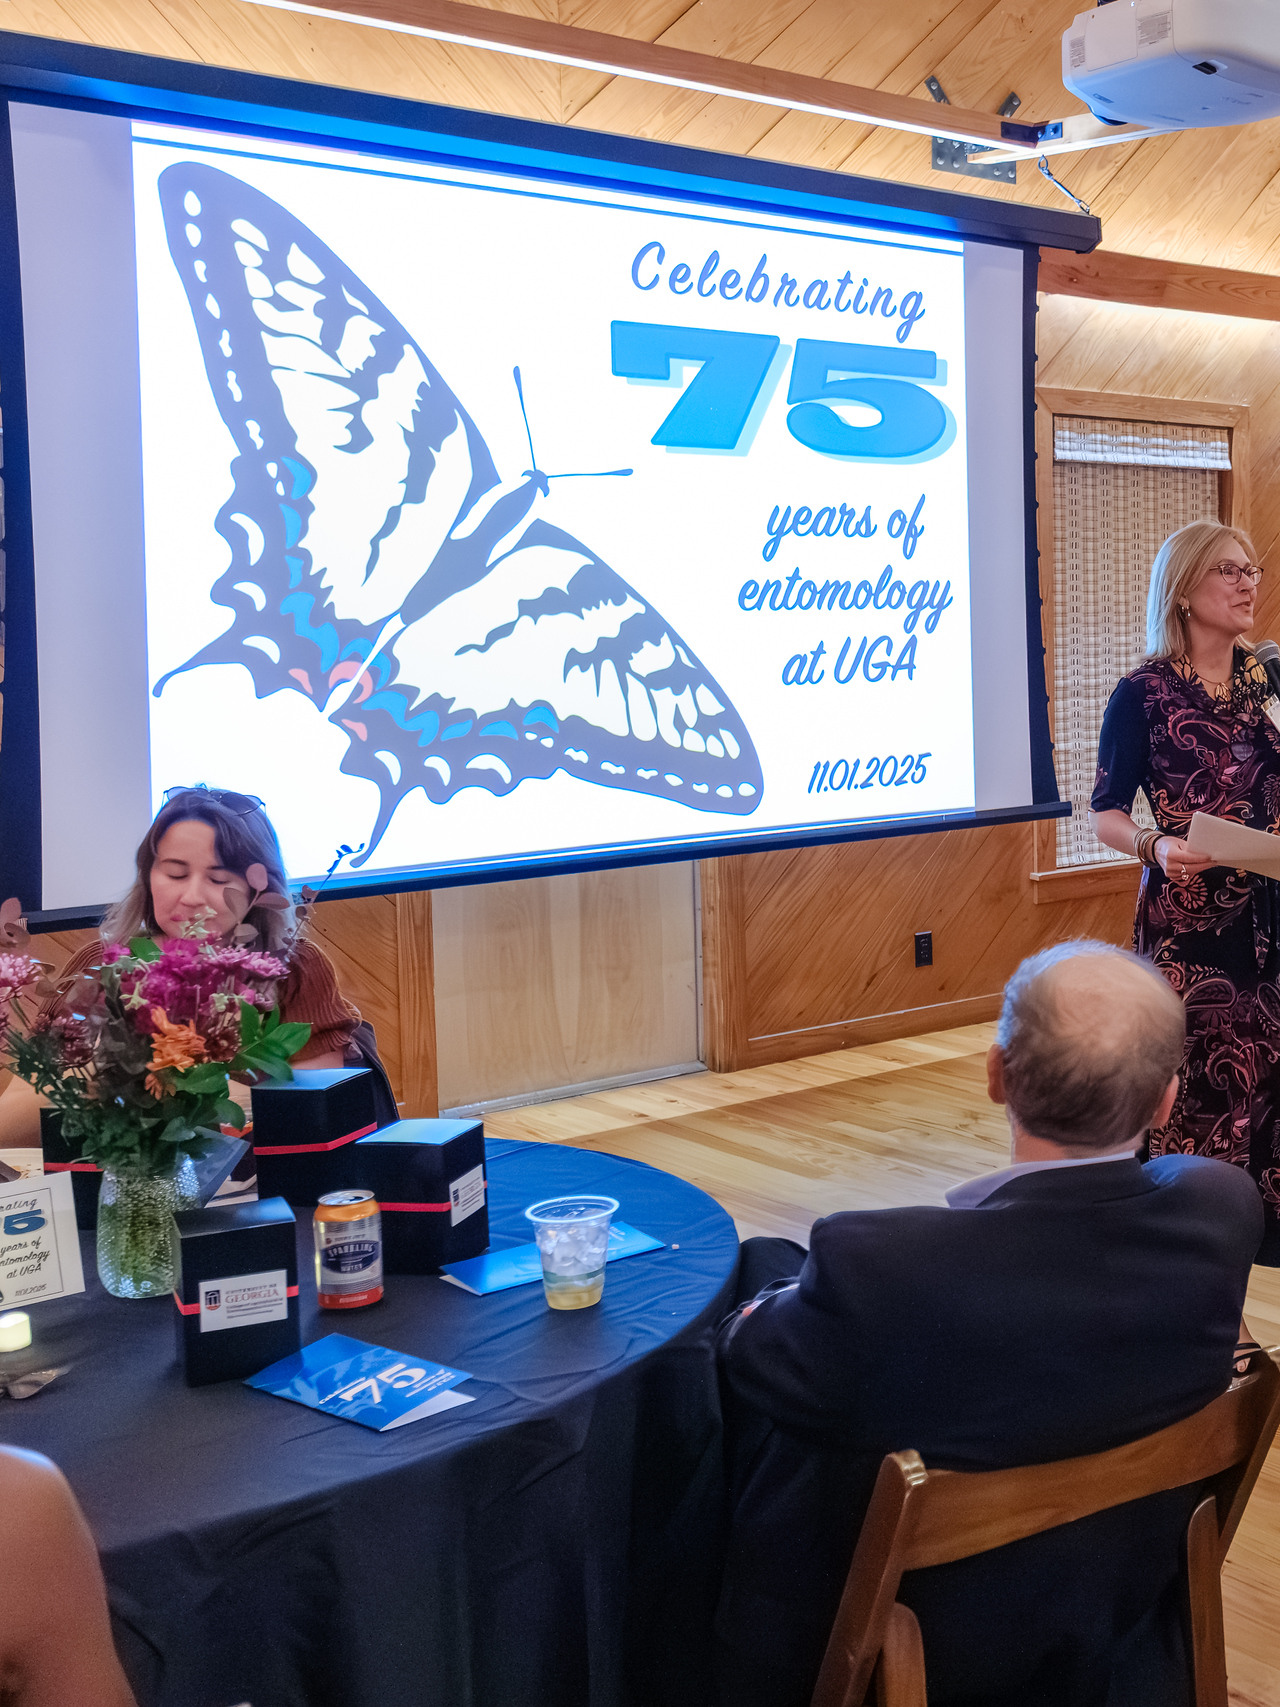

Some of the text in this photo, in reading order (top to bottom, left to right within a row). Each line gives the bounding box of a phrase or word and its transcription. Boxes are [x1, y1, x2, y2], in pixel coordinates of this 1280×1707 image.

[631, 241, 925, 343] Celebrating
[611, 321, 957, 464] 75
[762, 494, 925, 561] years of
[738, 565, 953, 634] entomology
[782, 635, 918, 685] at UGA
[808, 752, 931, 793] 11.01.2025
[0, 1198, 37, 1212] rating
[0, 1209, 48, 1235] 5
[0, 1236, 42, 1258] years of
[0, 1250, 50, 1267] ntomology
[6, 1262, 42, 1279] at UGA
[225, 1288, 280, 1304] GEORGIA
[338, 1363, 427, 1405] 75
